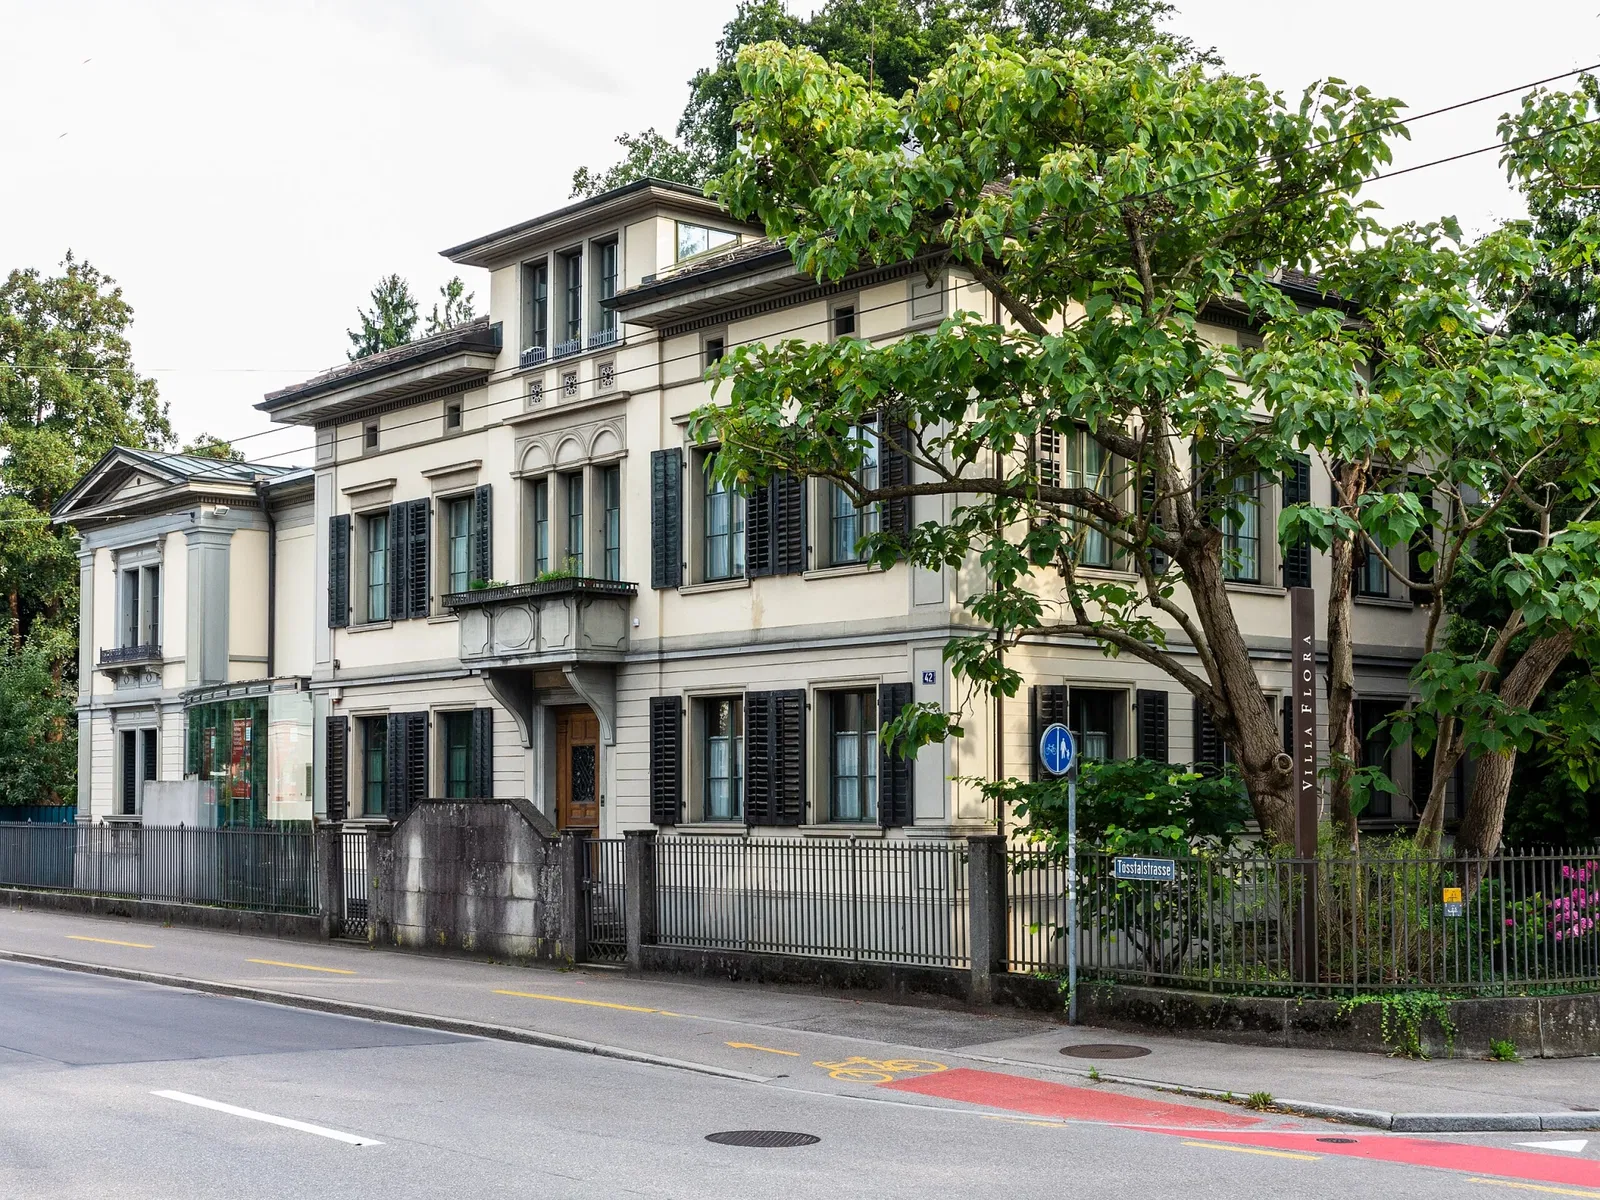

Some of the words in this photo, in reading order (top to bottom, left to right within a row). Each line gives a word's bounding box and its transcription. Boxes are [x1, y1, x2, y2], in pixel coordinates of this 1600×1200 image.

[924, 672, 933, 683] 42
[1301, 635, 1312, 714] FLORA
[1302, 727, 1313, 791] VILLA
[1117, 859, 1171, 876] Tösstalstrasse
